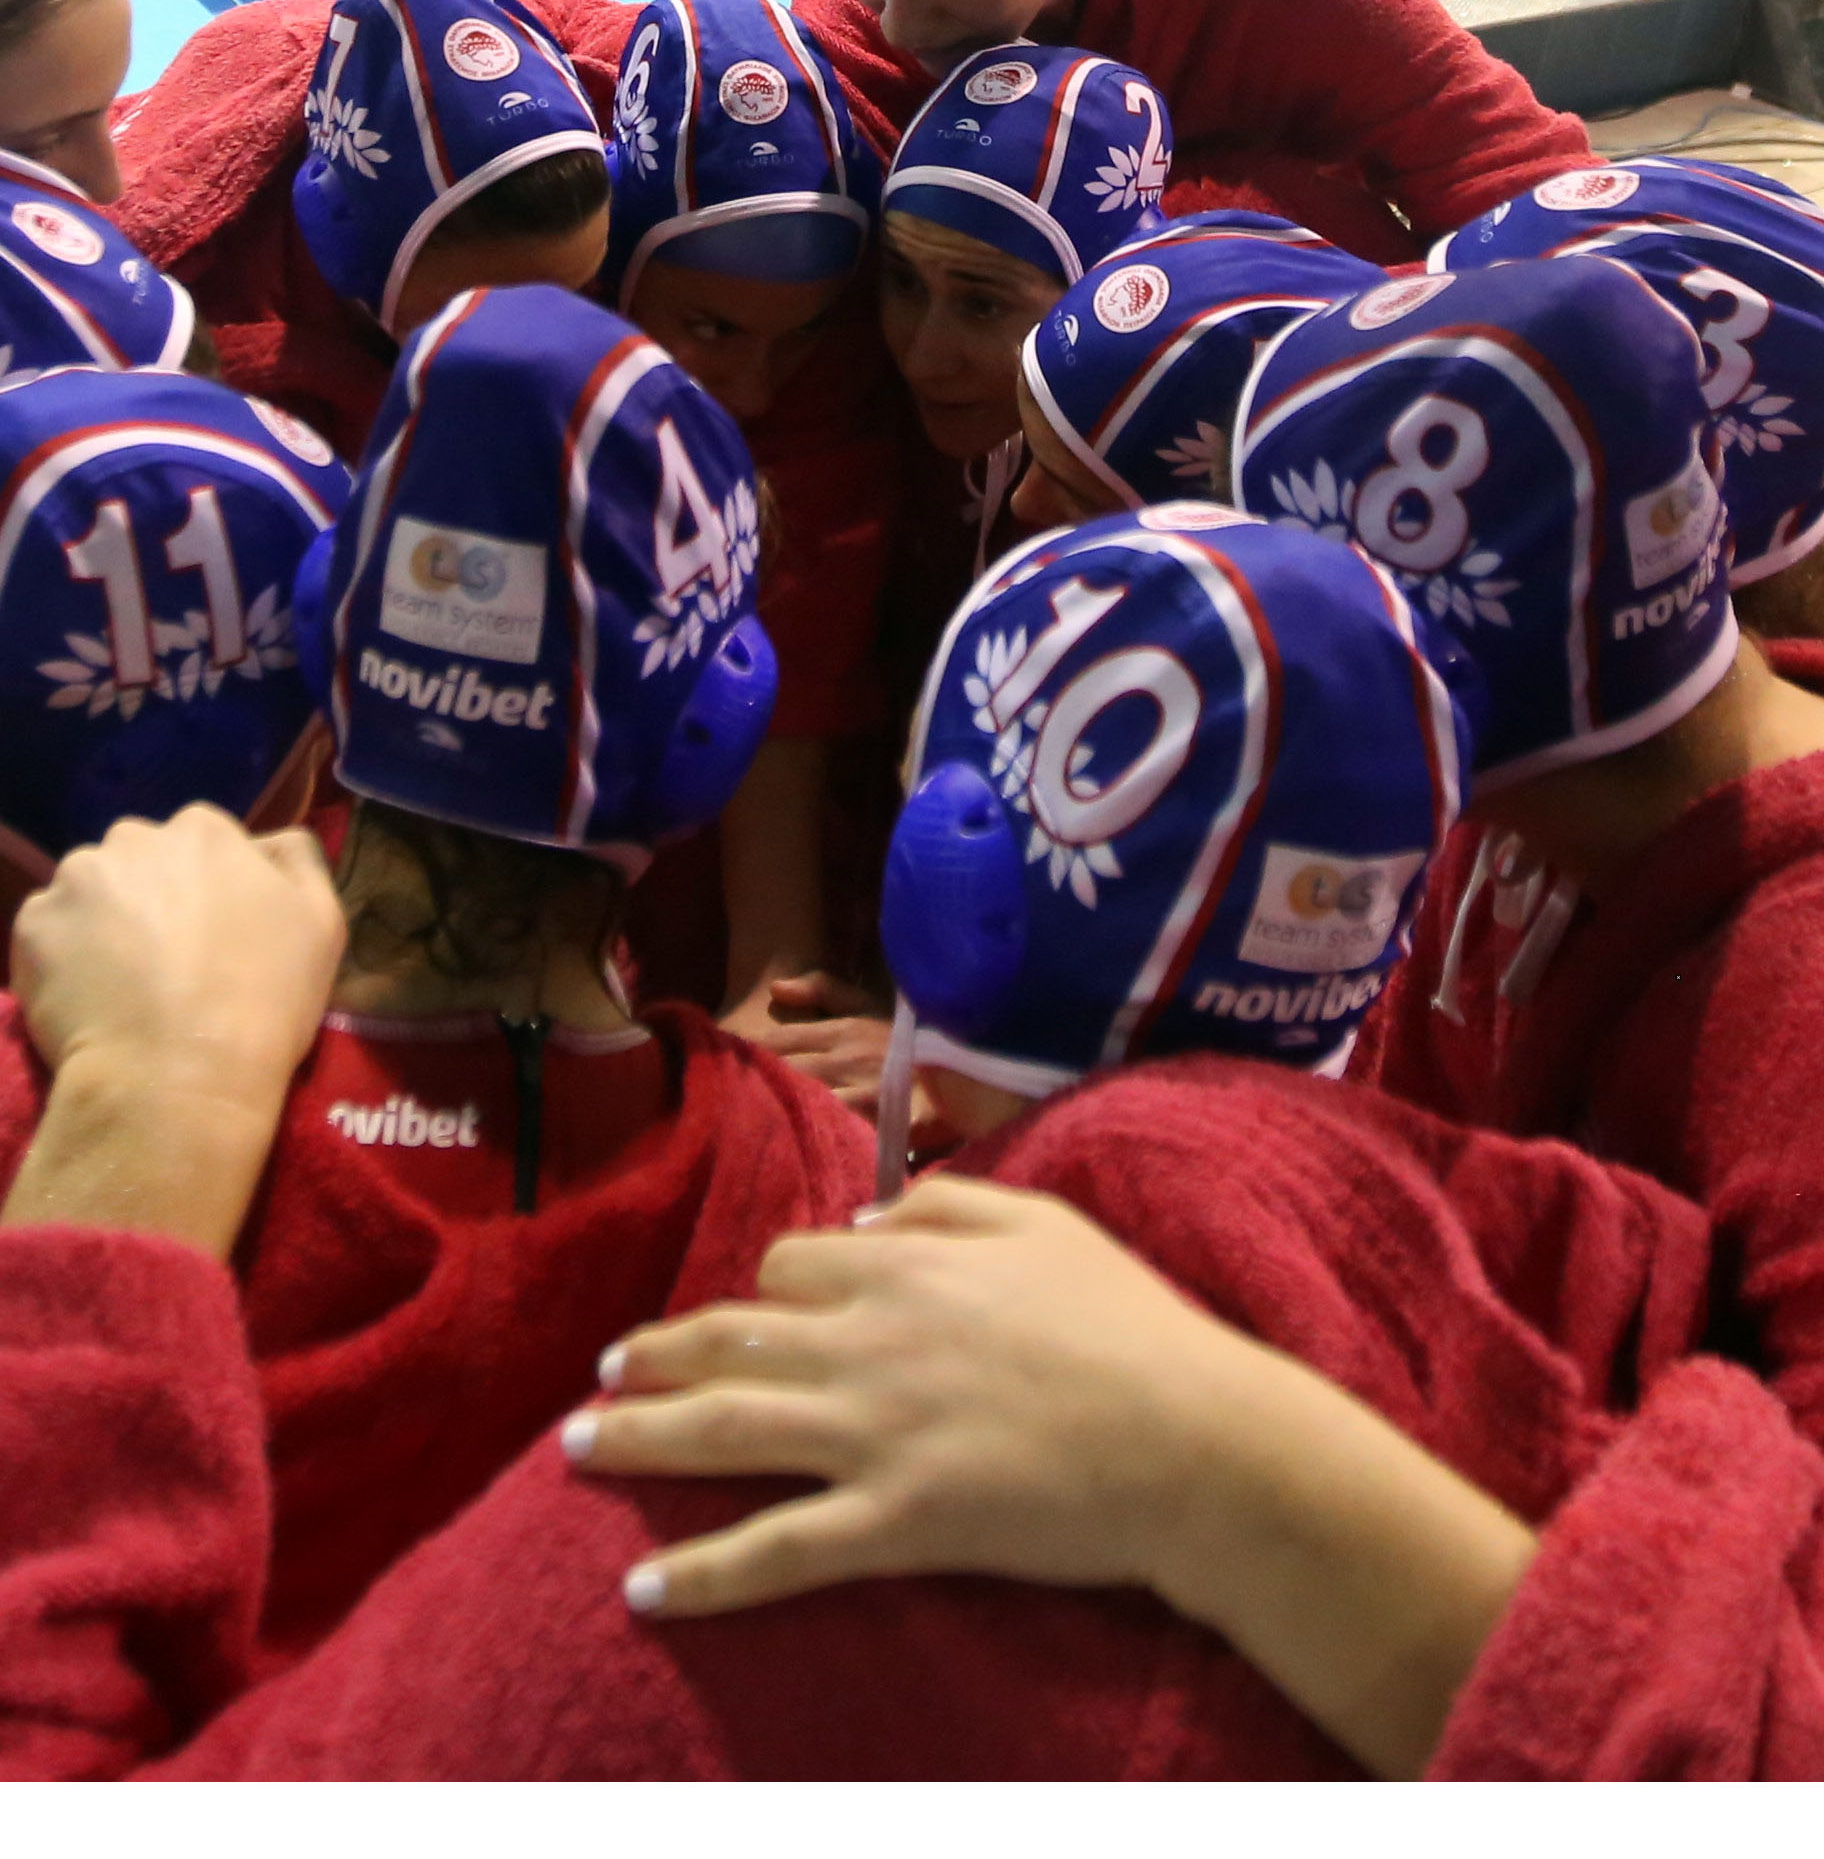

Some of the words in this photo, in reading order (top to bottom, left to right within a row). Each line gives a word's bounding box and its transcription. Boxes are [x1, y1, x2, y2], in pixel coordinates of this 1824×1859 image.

[320, 11, 360, 139] 7
[486, 96, 551, 126] TURBO
[618, 22, 661, 130] 6
[1122, 80, 1169, 192] 2
[1679, 265, 1774, 412] 3
[651, 414, 731, 600] 4
[1354, 394, 1493, 572] 8
[61, 484, 252, 691] 11
[356, 648, 557, 733] novibet
[987, 574, 1206, 847] 10
